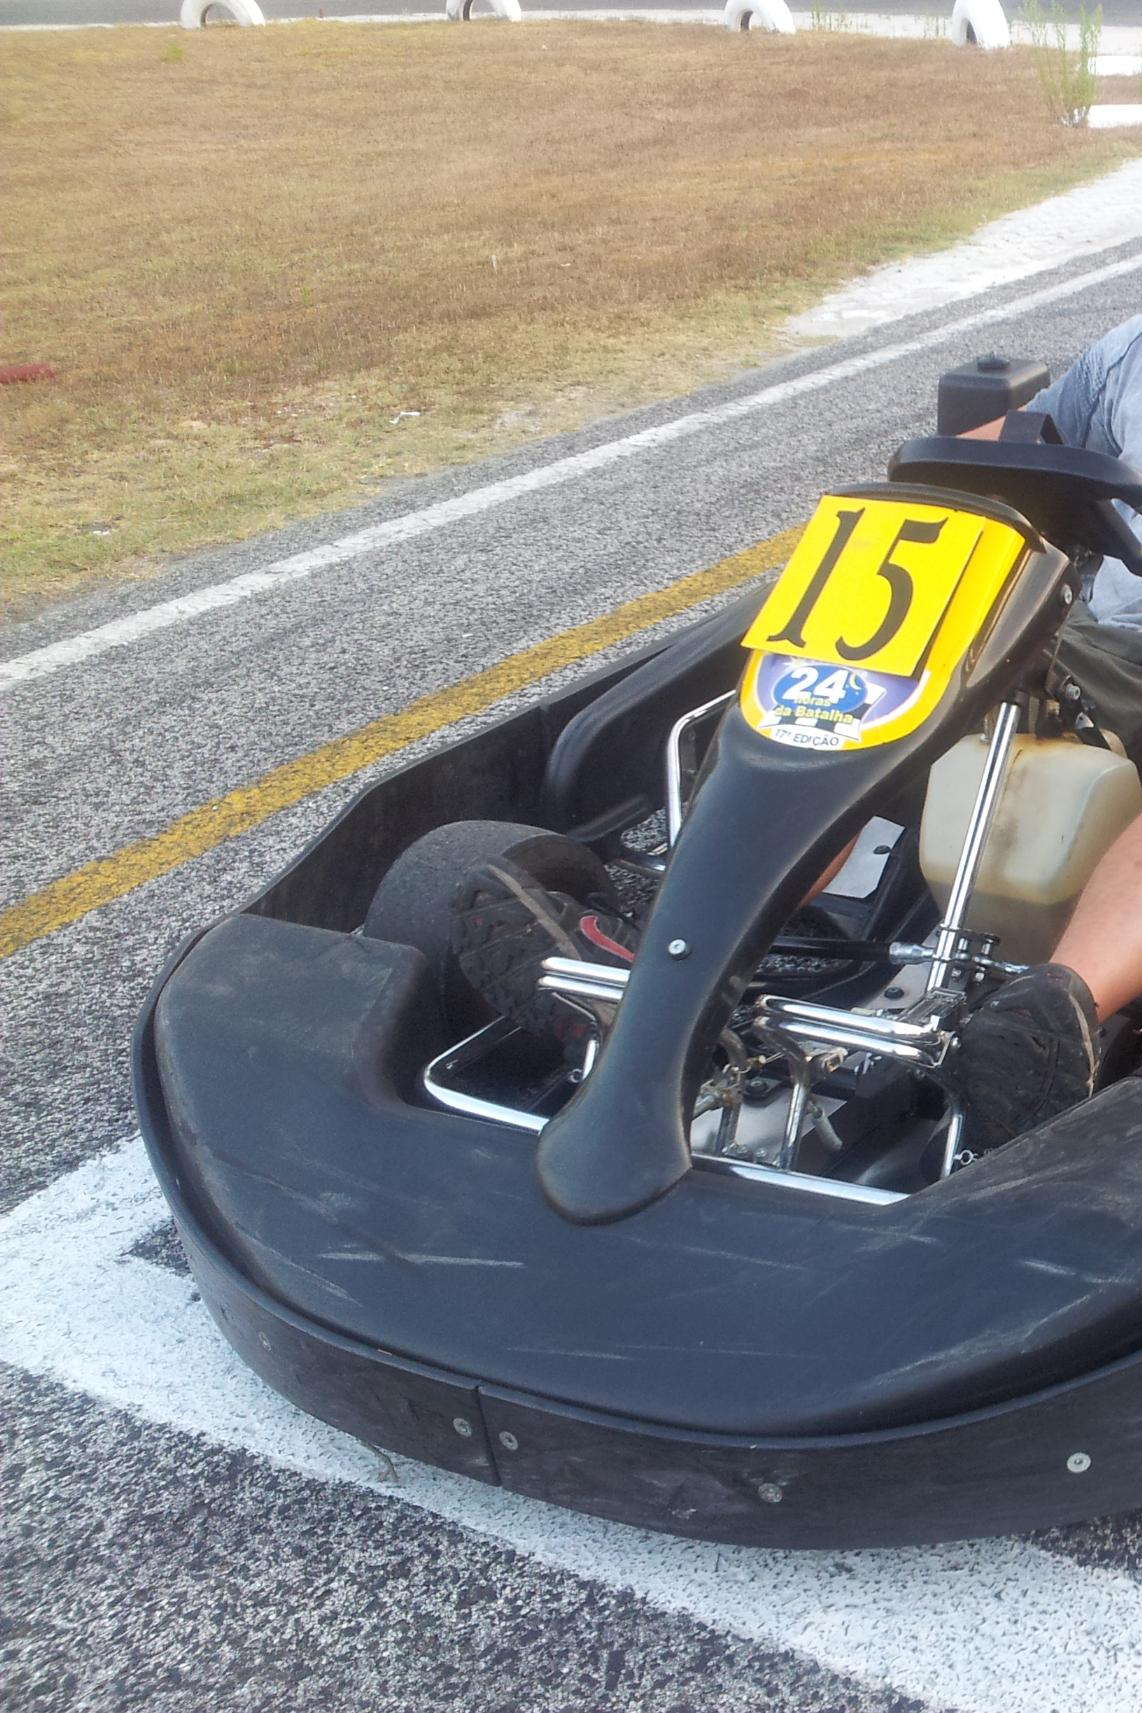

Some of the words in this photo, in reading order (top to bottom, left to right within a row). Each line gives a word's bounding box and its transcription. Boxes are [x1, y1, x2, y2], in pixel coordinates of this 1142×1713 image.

[766, 507, 948, 661] 15
[782, 667, 847, 704] 24
[774, 705, 792, 718] da
[795, 706, 854, 725] Batalha
[793, 732, 840, 747] EDIÇÃO
